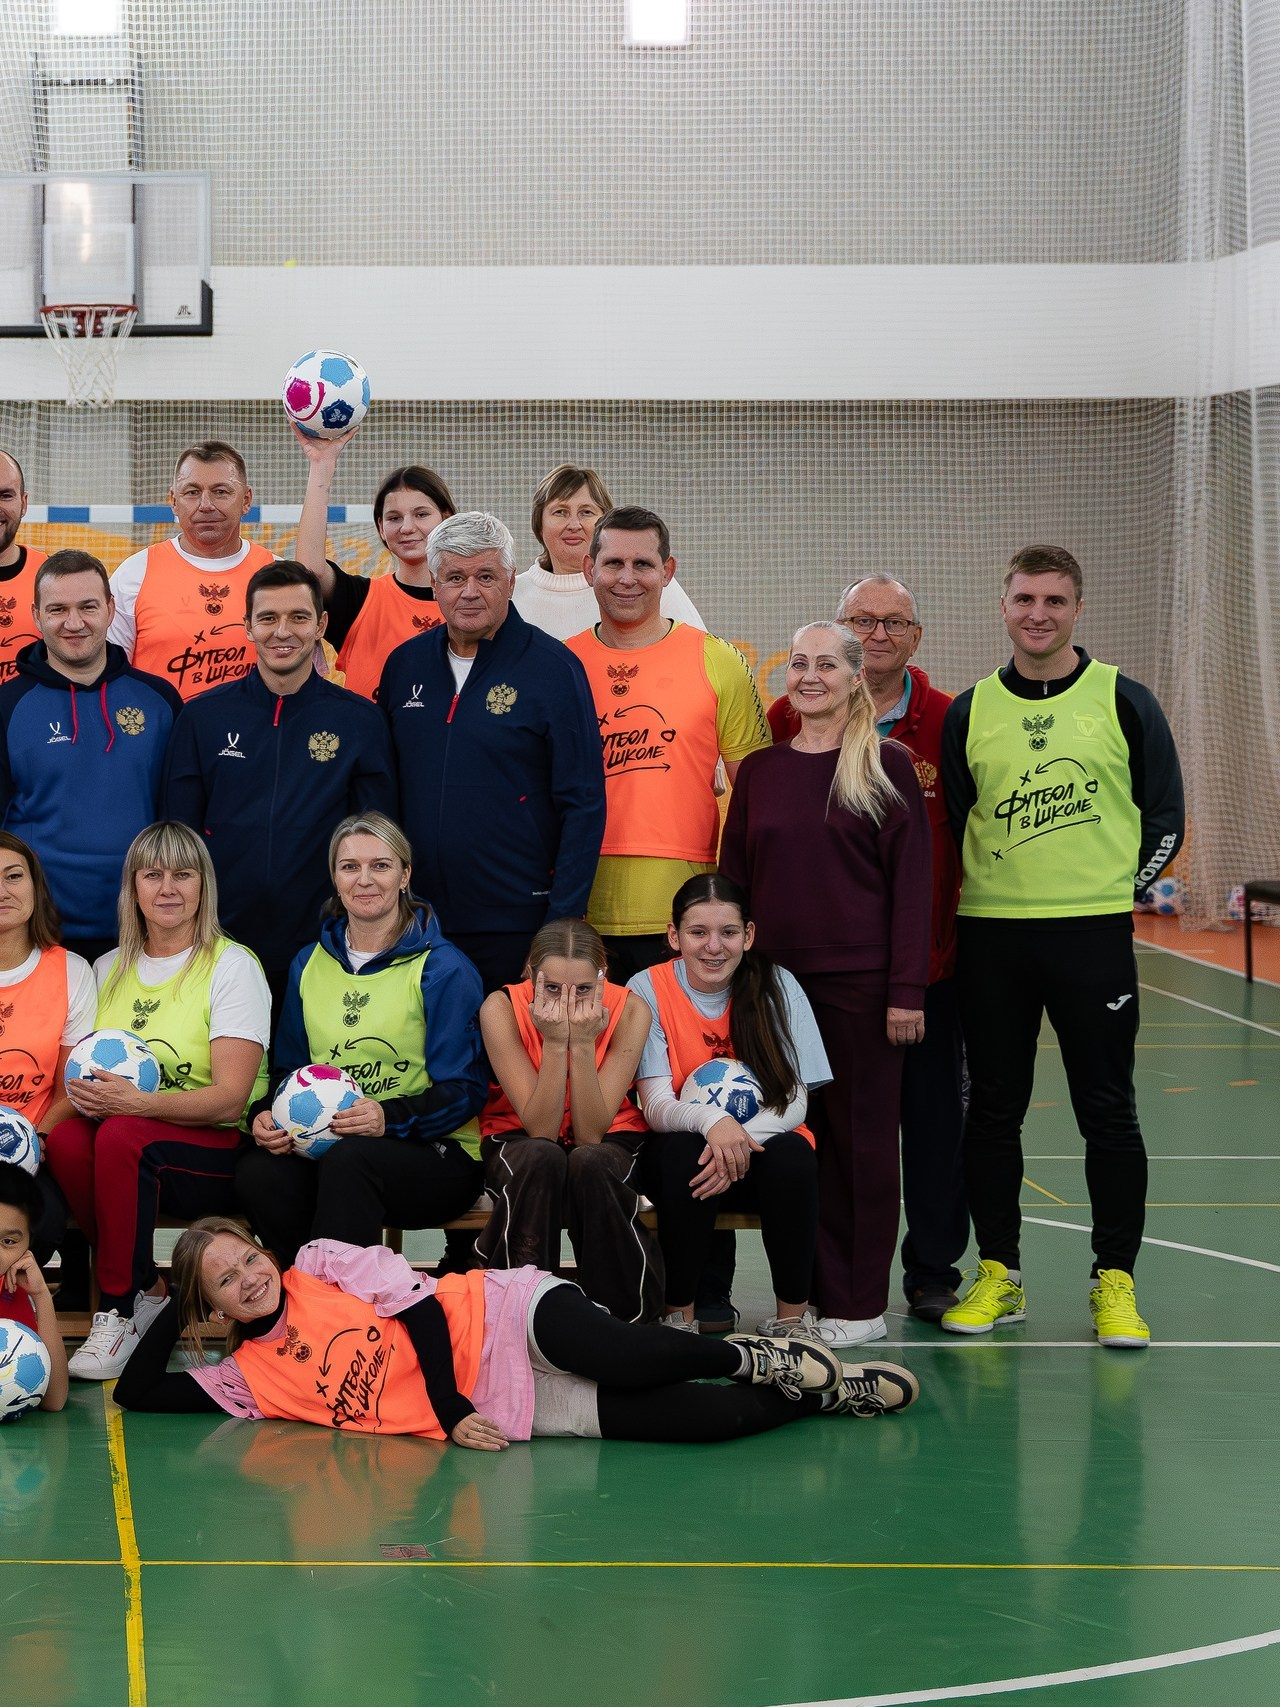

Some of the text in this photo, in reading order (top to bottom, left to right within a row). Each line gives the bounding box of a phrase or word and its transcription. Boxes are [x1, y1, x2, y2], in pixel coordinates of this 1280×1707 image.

[167, 646, 247, 690] ФУТБОЛ
[600, 728, 649, 751] УТБОЛ
[607, 746, 666, 770] ШКОЛЕ
[994, 782, 1075, 838] ФУТБОЛ
[1033, 798, 1094, 829] ШКОЛЕ
